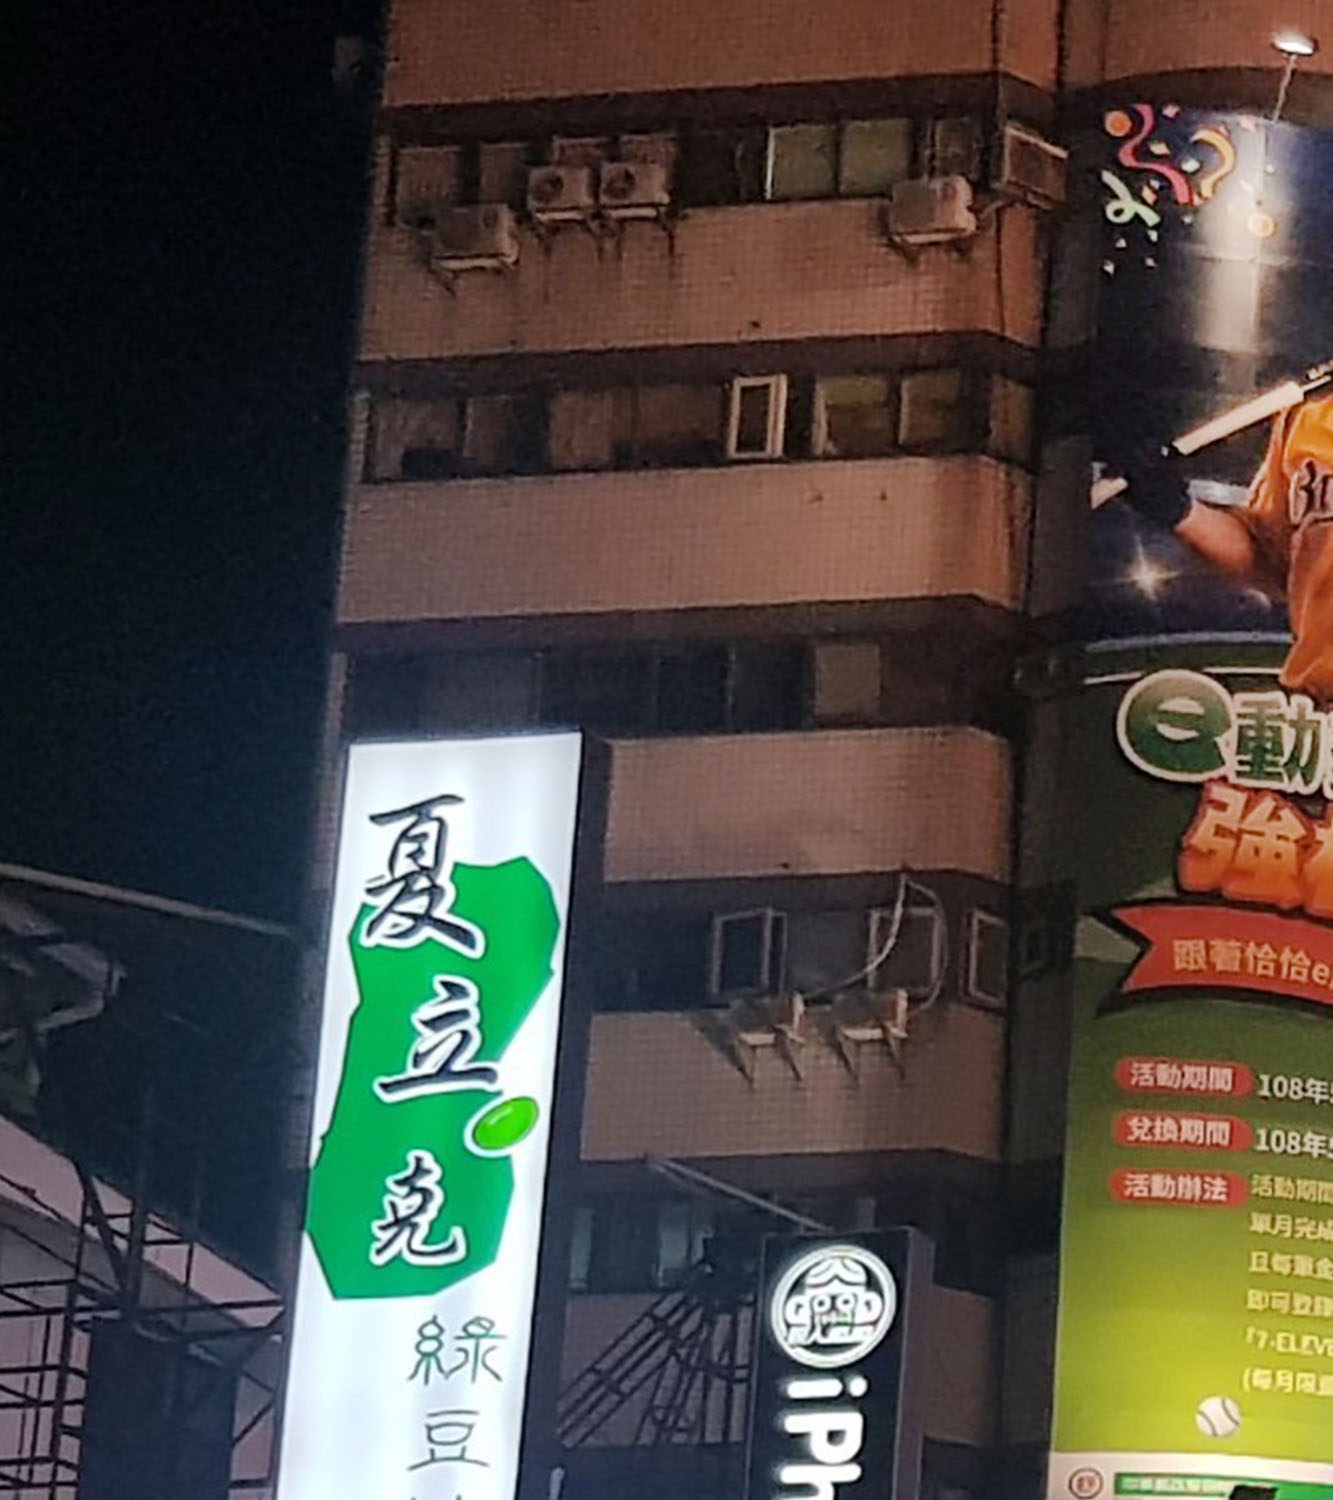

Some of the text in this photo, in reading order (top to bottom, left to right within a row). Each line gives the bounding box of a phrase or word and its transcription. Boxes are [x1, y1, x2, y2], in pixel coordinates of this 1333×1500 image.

[360, 793, 502, 1269] 夏立克
[1129, 1062, 1235, 1094] 活動期間
[1126, 1116, 1232, 1149] 兌換期間
